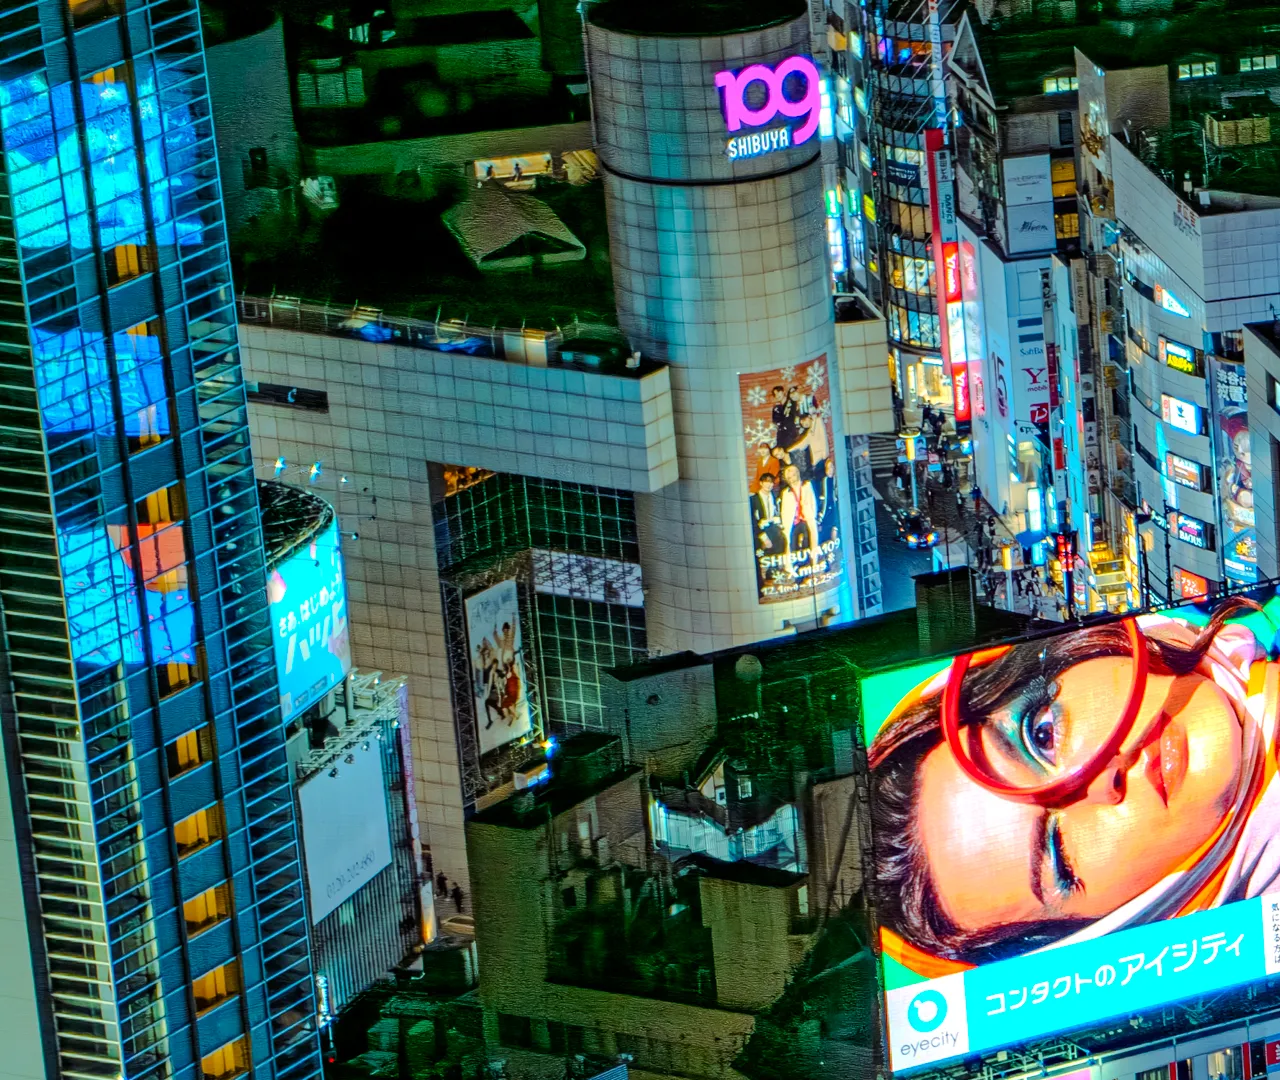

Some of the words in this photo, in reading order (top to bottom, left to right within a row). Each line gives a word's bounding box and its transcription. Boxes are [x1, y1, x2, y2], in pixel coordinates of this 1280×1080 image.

[714, 55, 821, 145] 109
[727, 127, 789, 158] SHIBUYA
[759, 537, 841, 569] SHIBUYA109
[786, 558, 827, 579] Xmas
[985, 931, 1246, 1017] コンタクトのアイシティ
[899, 1029, 960, 1057] eyecity
